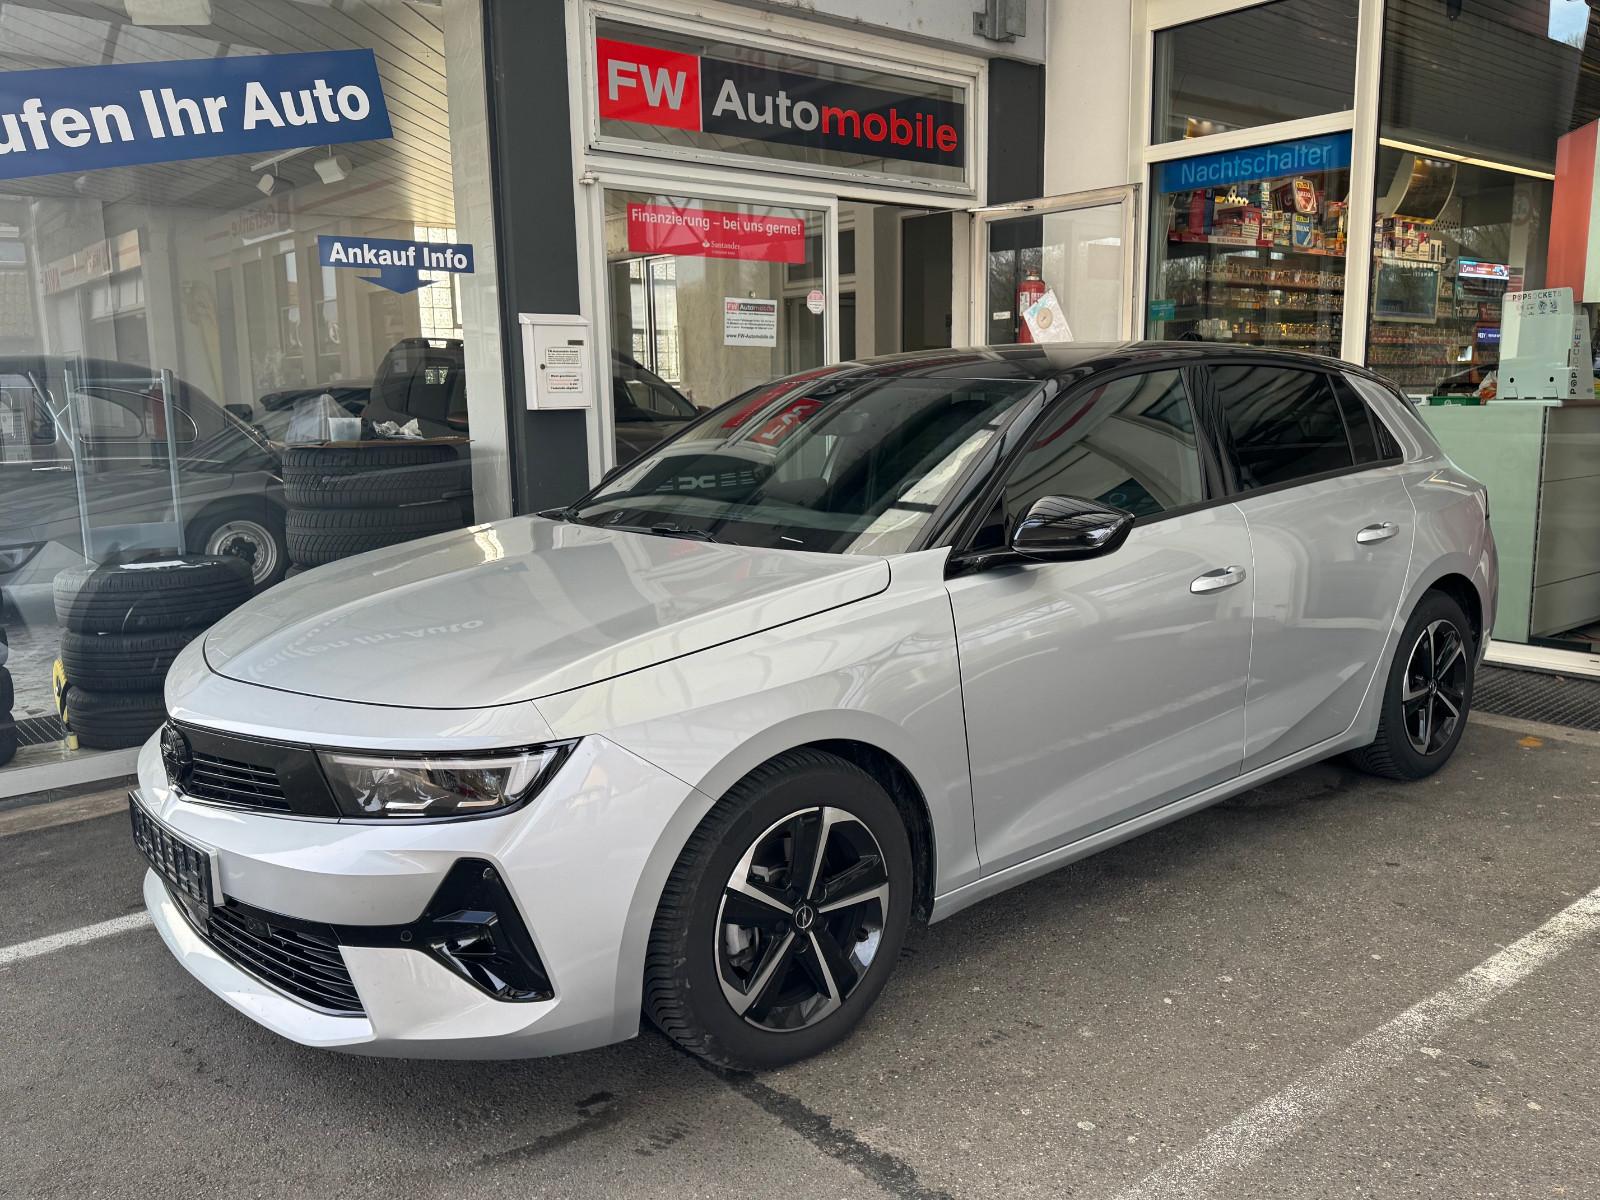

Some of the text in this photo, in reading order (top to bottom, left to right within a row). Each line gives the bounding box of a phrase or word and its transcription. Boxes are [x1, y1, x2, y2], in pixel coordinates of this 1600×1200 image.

[139, 88, 228, 139] Ihr
[243, 79, 371, 130] Auto
[607, 58, 958, 152] FW Automobile
[1181, 144, 1332, 185] Nachtschalter
[631, 208, 710, 230] Finanzierung
[723, 216, 740, 231] bei
[743, 222, 764, 233] uns
[766, 223, 801, 236] gerne!
[329, 242, 468, 269] Ankauf Info
[710, 240, 741, 250] Santander
[727, 302, 738, 310] FW
